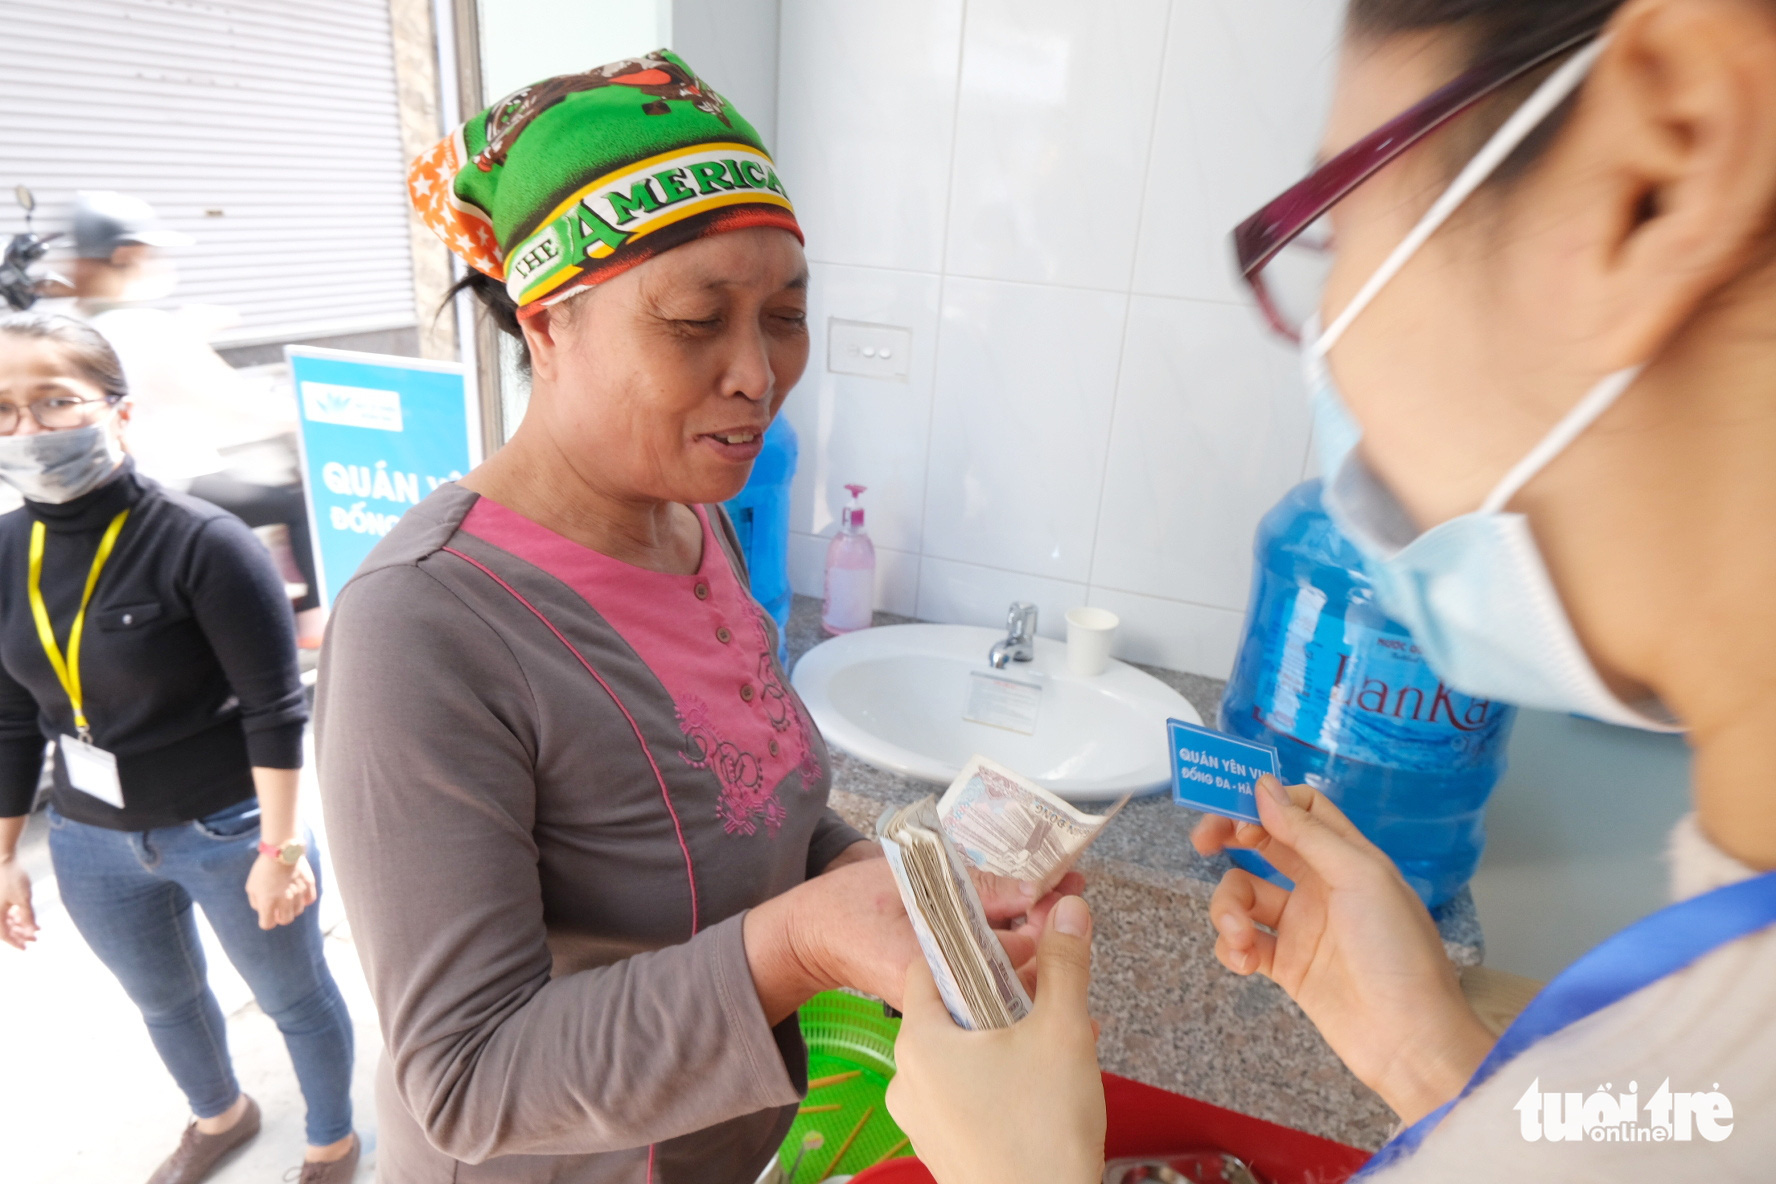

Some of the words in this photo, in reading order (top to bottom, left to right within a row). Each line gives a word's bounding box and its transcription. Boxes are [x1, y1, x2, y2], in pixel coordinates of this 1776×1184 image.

[515, 238, 558, 280] THE
[571, 158, 791, 266] AMERICA
[323, 460, 420, 505] QUÁN
[1179, 747, 1219, 769] QUÁN
[1221, 758, 1247, 777] YÊN
[1181, 765, 1213, 785] ĐỐNG
[1215, 776, 1231, 790] ĐA
[1238, 781, 1253, 796] HÀ
